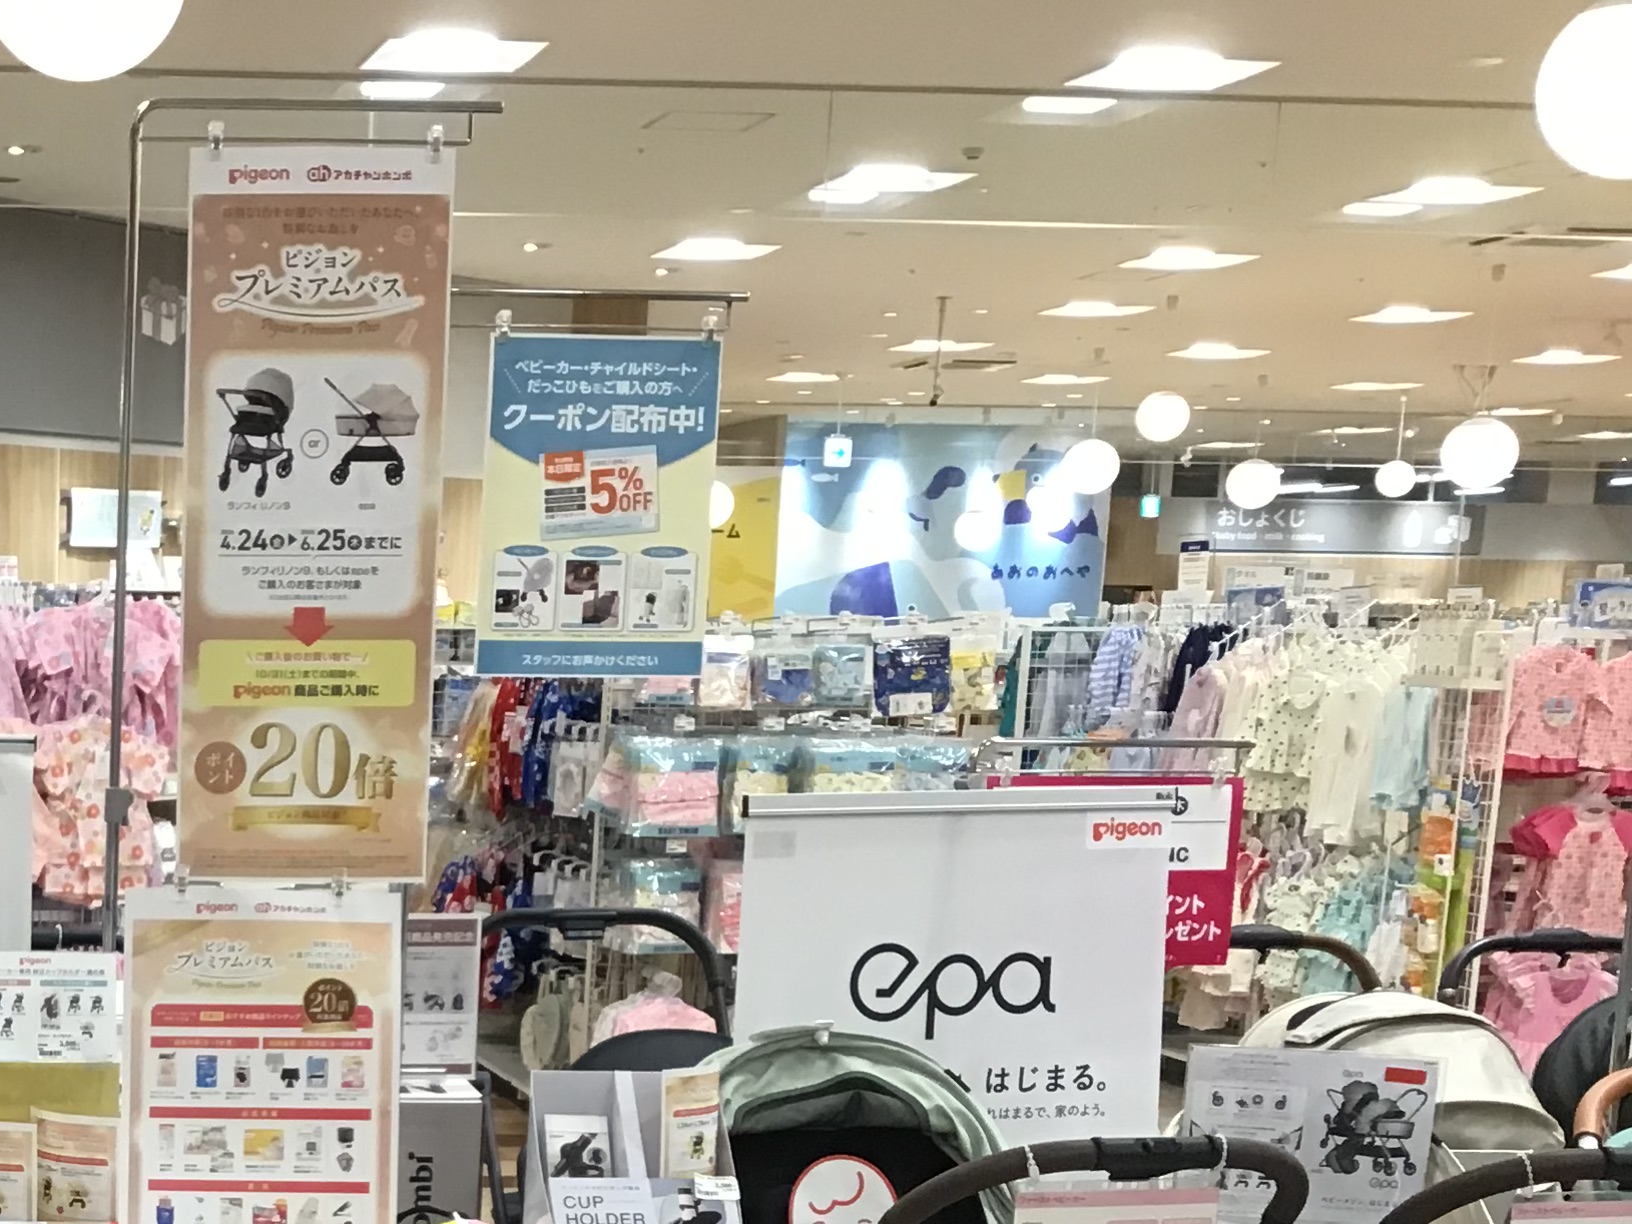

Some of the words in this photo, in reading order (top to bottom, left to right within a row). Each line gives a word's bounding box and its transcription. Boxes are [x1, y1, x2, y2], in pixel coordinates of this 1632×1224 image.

[228, 165, 290, 184] pigeon
[286, 248, 356, 268] ピジョン
[235, 270, 401, 298] プレミアムパス
[503, 403, 705, 434] クーポン配布中!
[619, 492, 653, 512] OFF
[1217, 509, 1307, 528] おしょくじ
[233, 682, 291, 699] pigeon
[1092, 817, 1162, 842] pigeon
[196, 902, 239, 914] pigeon
[204, 940, 246, 953] ピジョン
[176, 953, 273, 969] プレミアムパス
[850, 942, 1056, 1040] epa
[986, 1064, 1107, 1094] はじまる。
[563, 1196, 604, 1210] CUP
